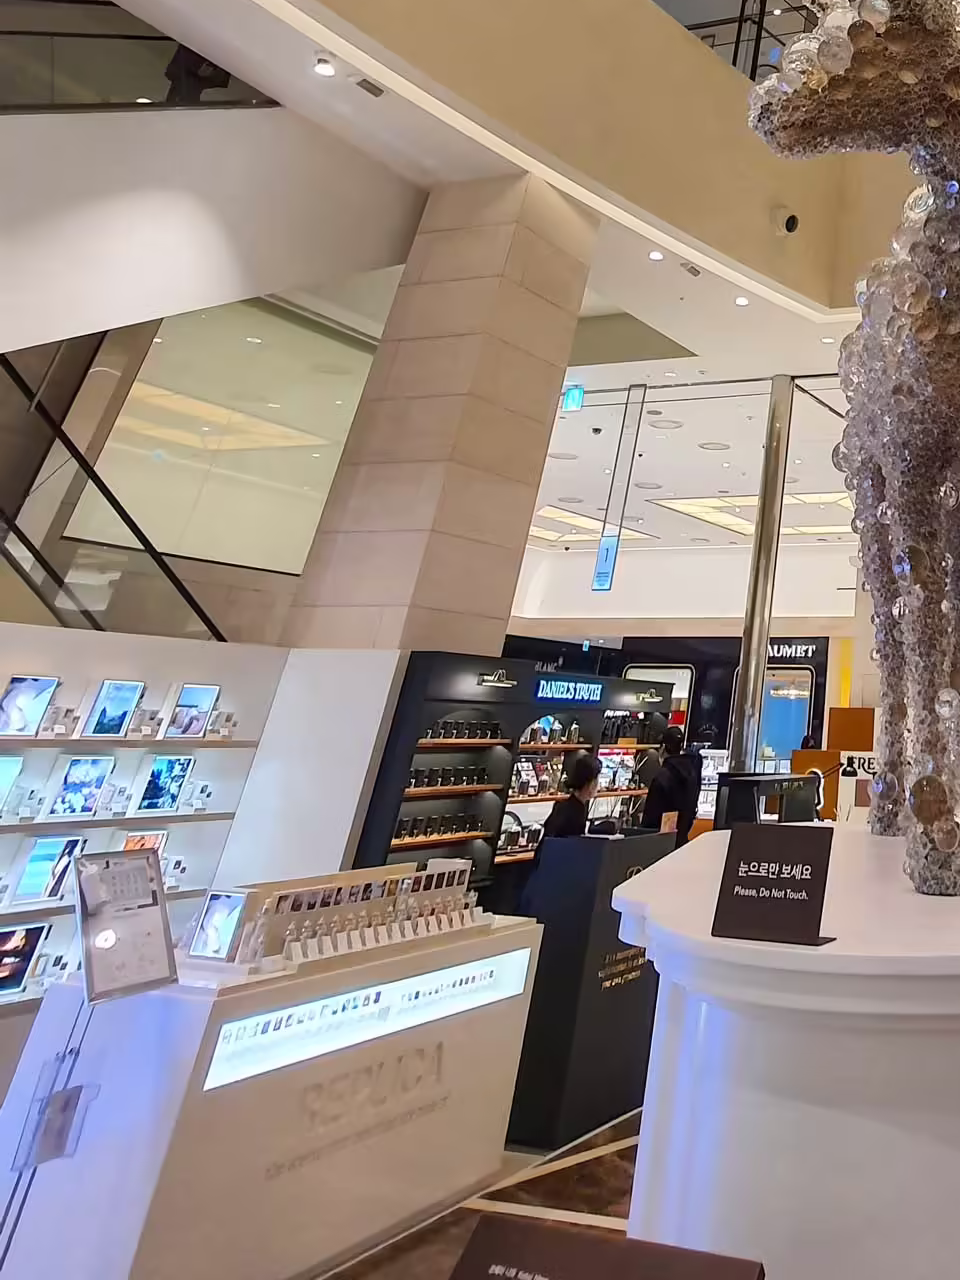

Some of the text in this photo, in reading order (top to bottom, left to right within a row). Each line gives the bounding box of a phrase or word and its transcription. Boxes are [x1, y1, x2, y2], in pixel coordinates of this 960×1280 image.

[575, 683, 602, 701] TRUTH
[738, 861, 812, 880] 눈으로만 보세요
[733, 885, 809, 900] Please, Do Not Touch.
